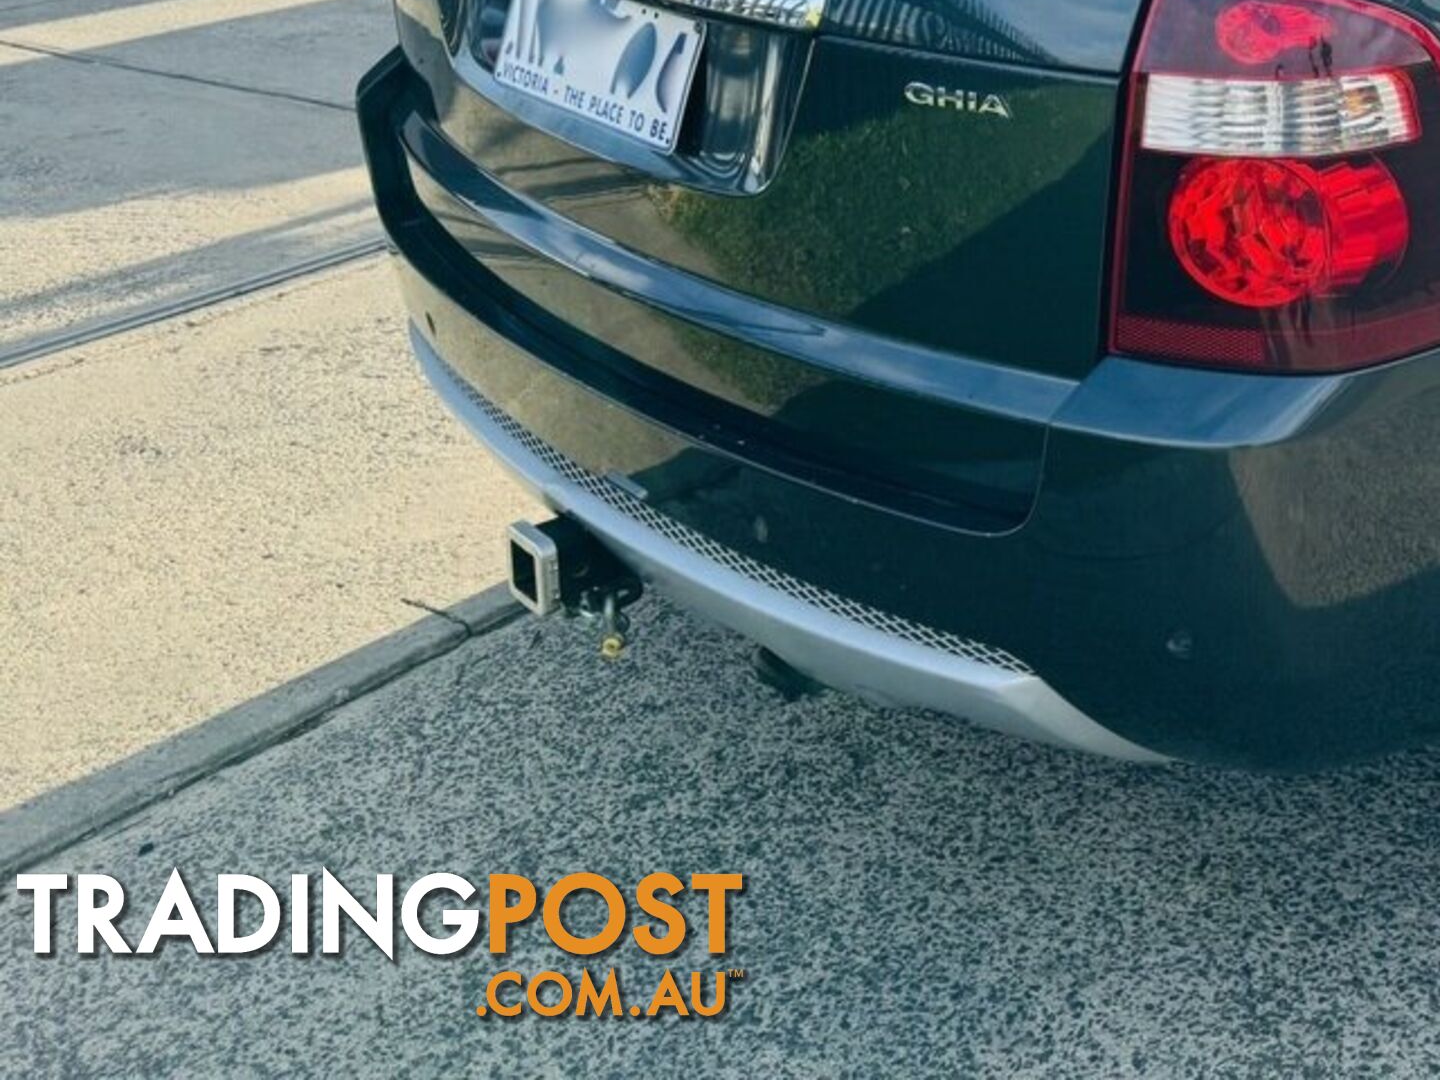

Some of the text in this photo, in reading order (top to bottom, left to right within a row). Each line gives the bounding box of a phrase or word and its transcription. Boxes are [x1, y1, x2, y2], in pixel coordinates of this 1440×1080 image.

[501, 62, 548, 98] VICTORIA
[564, 85, 585, 109] THE
[589, 95, 623, 124] PLACE
[629, 109, 645, 133] TO
[904, 81, 1010, 118] GHIA
